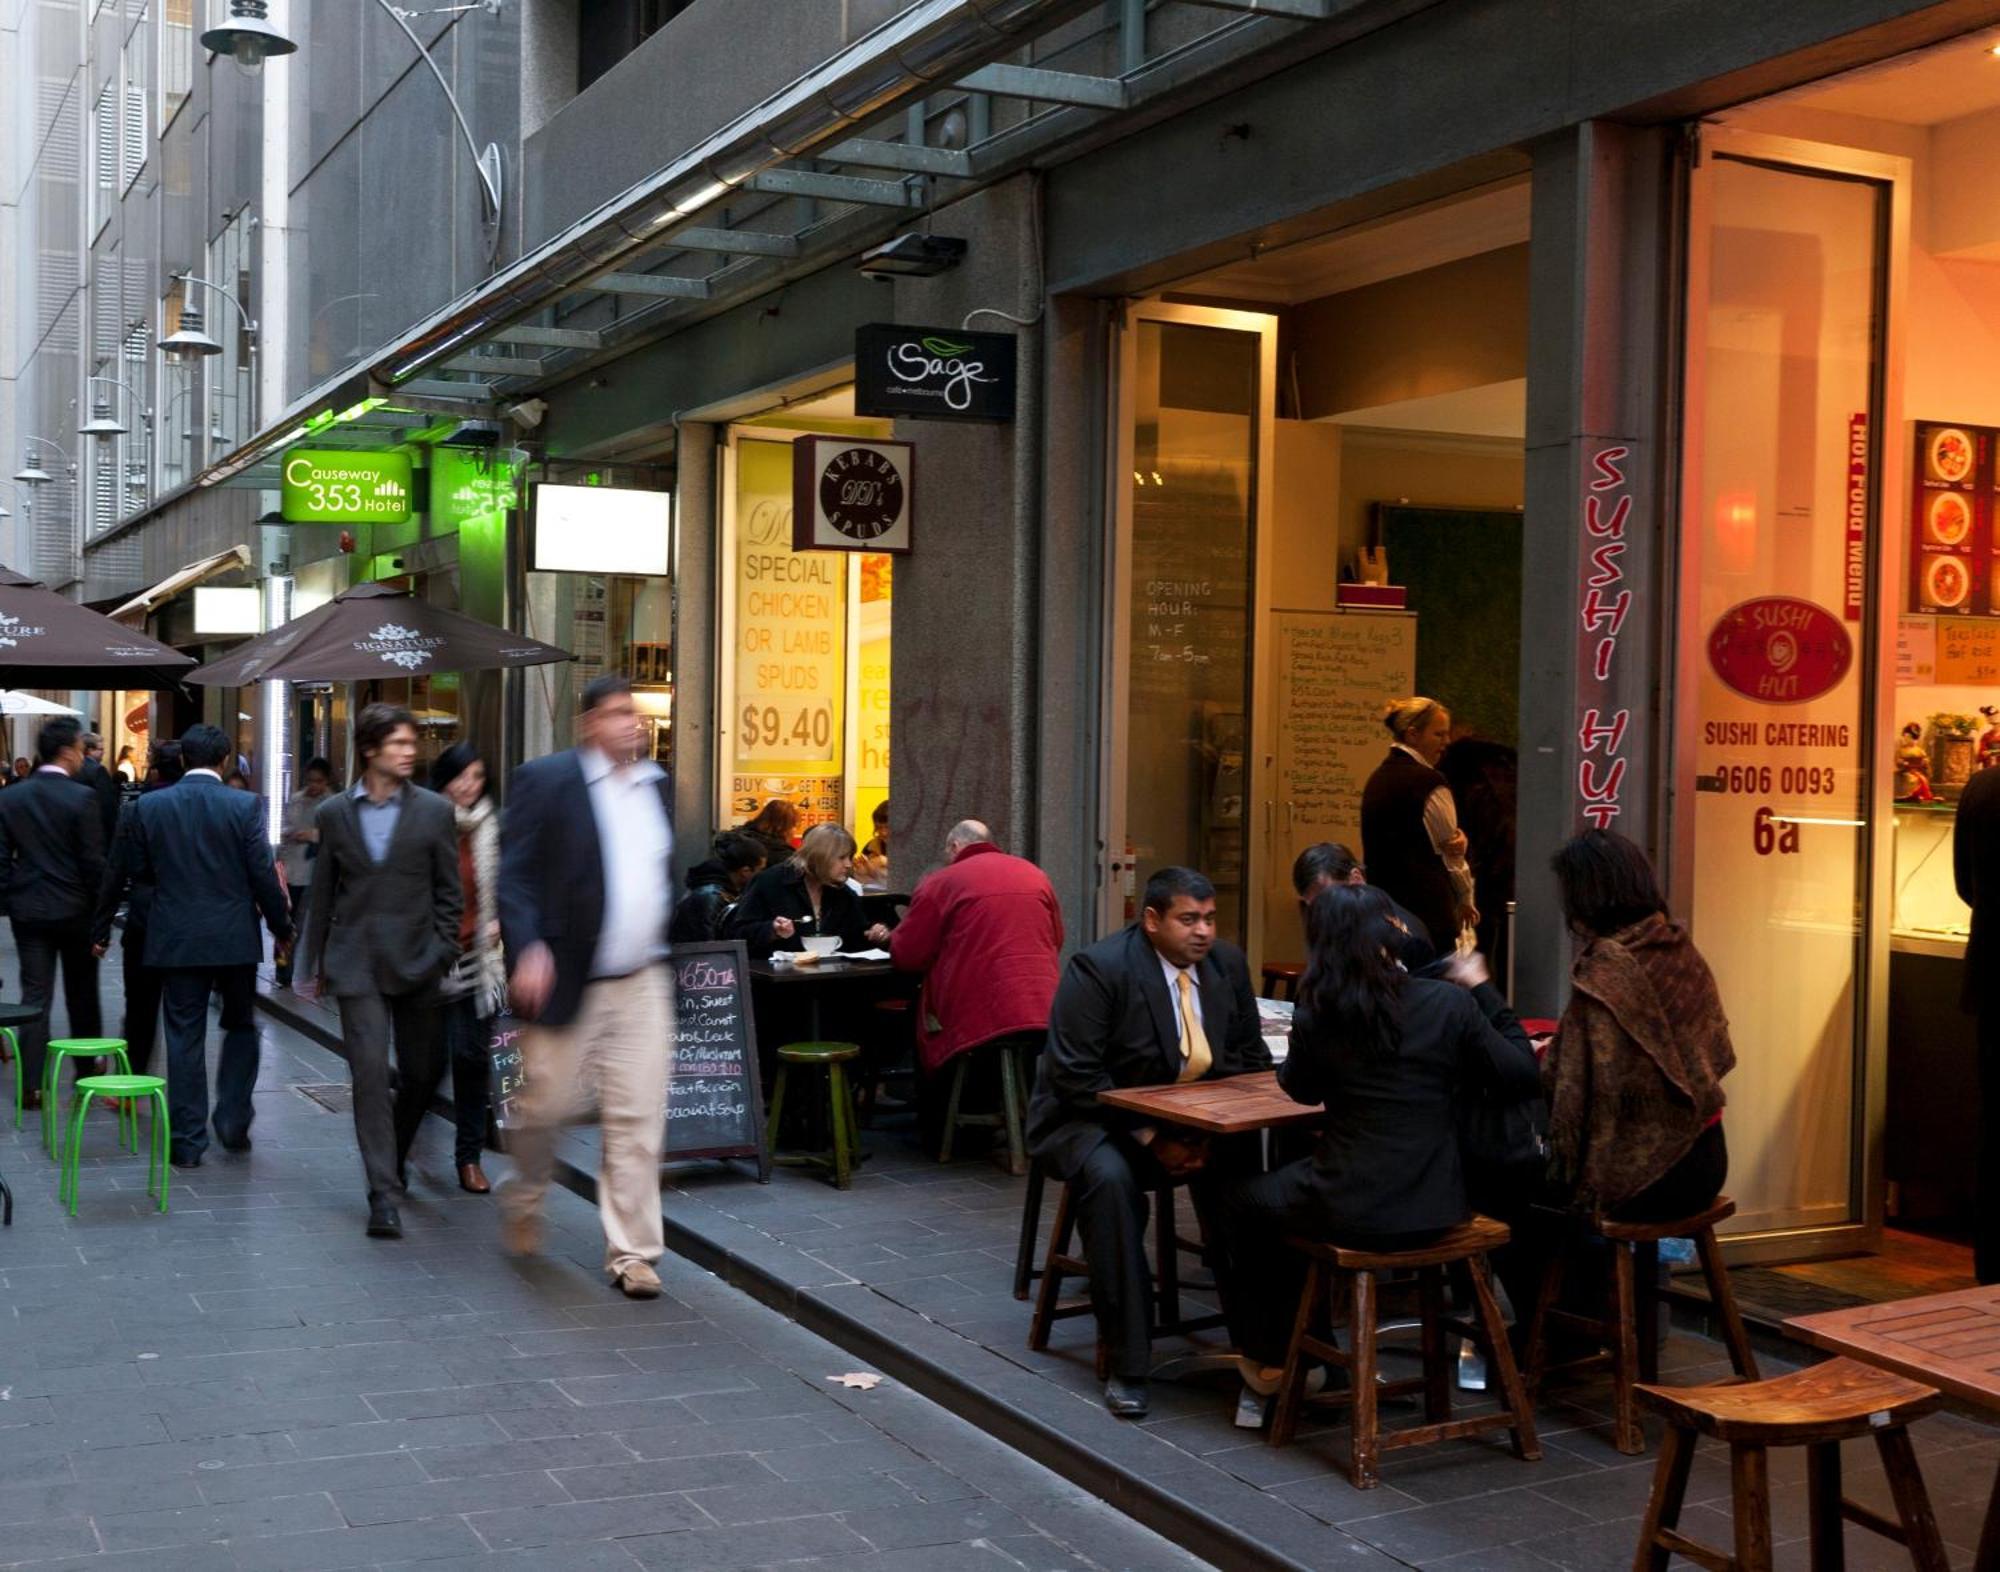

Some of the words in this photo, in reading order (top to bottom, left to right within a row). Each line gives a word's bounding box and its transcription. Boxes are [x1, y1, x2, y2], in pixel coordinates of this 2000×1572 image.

[887, 343, 999, 410] Sage
[286, 459, 380, 487] Causeway
[825, 451, 899, 485] KEBABS
[307, 484, 361, 512] 353
[365, 499, 405, 512] Hotel
[830, 512, 892, 538] SPUDS
[745, 554, 832, 585] SPECIAL
[1582, 447, 1632, 681] SUSHI
[1146, 581, 1211, 597] OPENING
[748, 591, 829, 618] CHICKEN
[1752, 605, 1814, 631] SUSHI
[352, 637, 447, 651] SIGNATURE
[745, 627, 772, 653] OR
[783, 630, 831, 655] LAMB
[757, 664, 818, 690] SPUDS
[1758, 674, 1799, 696] HUT
[741, 702, 830, 750] $9.40
[1705, 721, 1757, 745] SUSHI
[1765, 723, 1849, 747] CATERING
[1578, 709, 1629, 829] HUT
[1716, 765, 1772, 794] 9606
[1781, 766, 1835, 795] 0093
[734, 778, 763, 793] BUY
[799, 779, 817, 793] GET
[820, 779, 841, 794] THE
[735, 797, 760, 813] 3
[797, 796, 810, 811] 4
[1754, 806, 1800, 855] 6a
